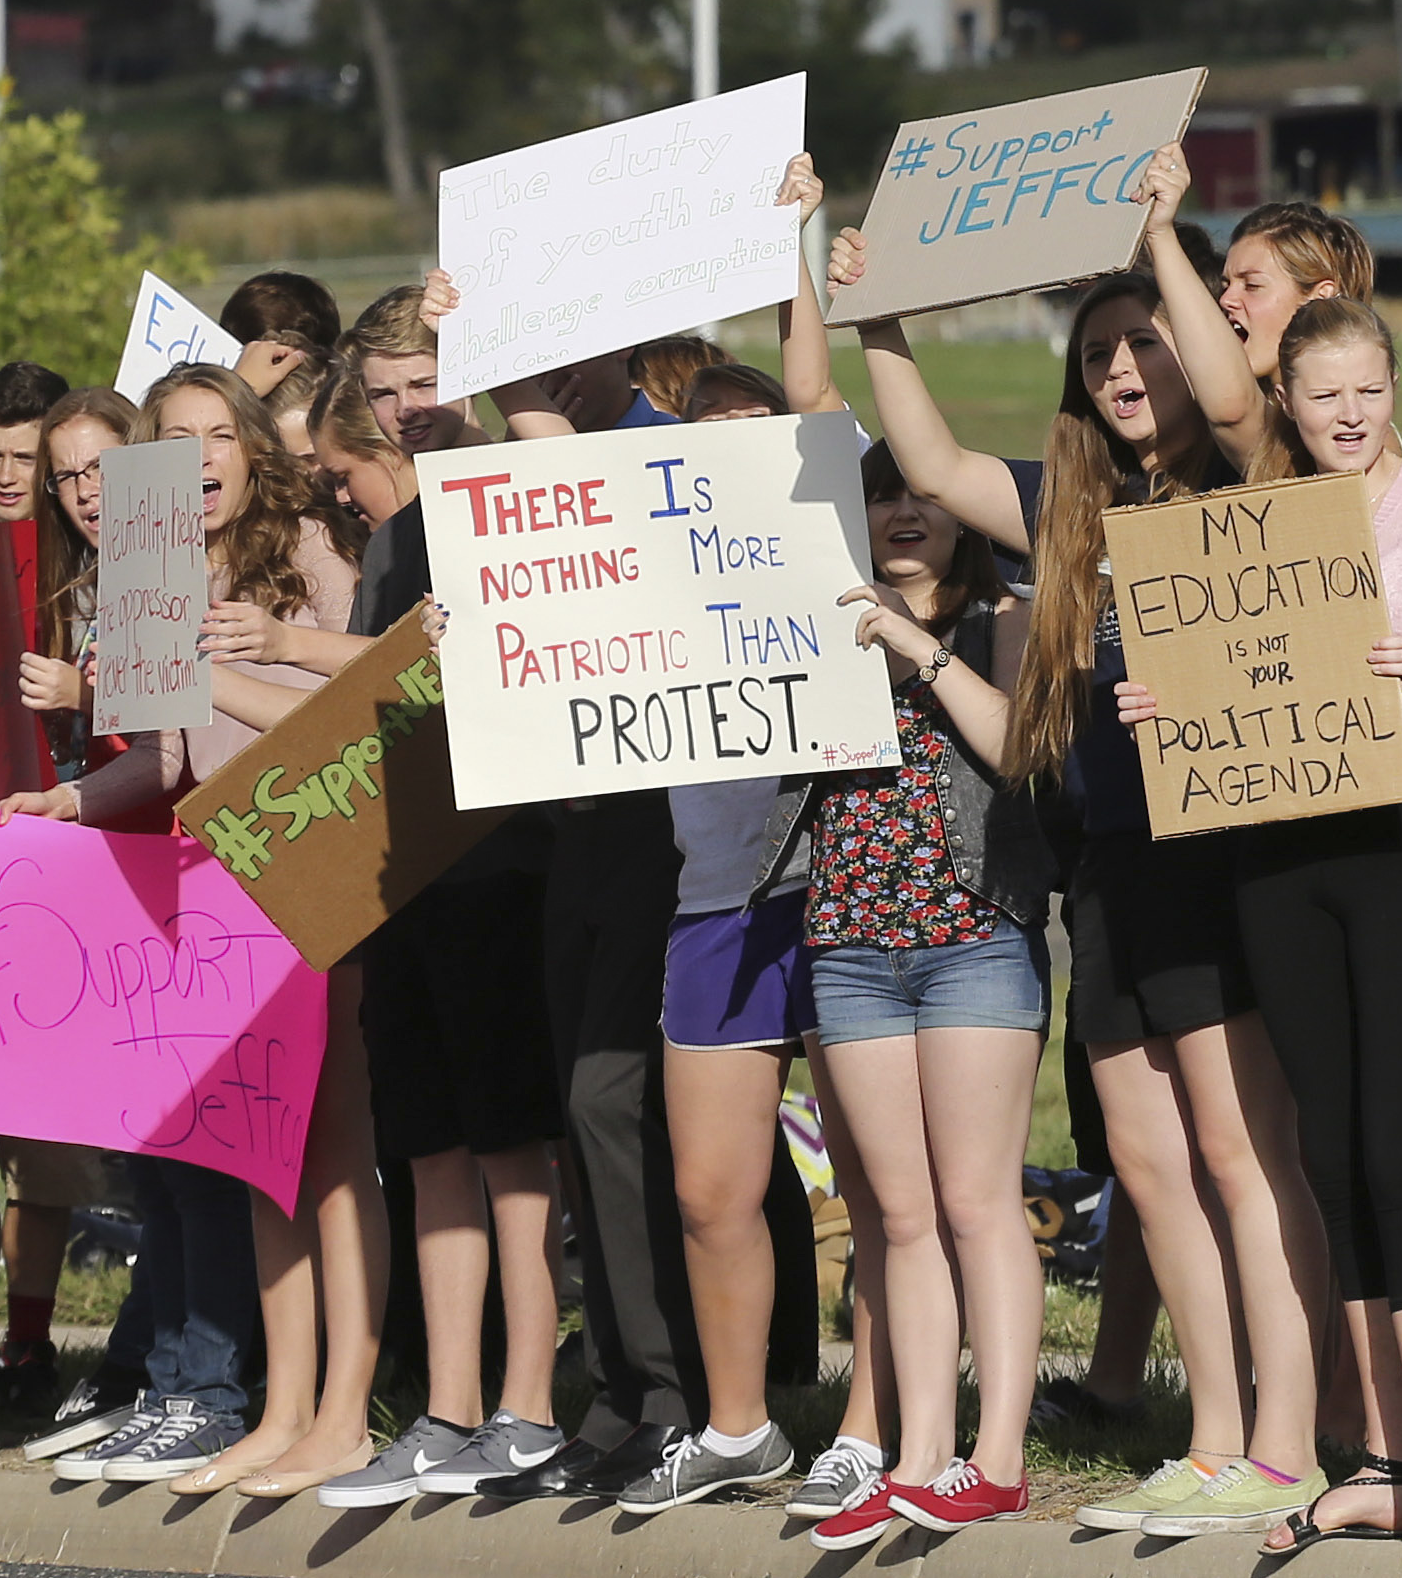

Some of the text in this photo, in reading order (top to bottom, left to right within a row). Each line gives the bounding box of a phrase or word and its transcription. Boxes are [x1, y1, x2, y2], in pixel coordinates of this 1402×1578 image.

[588, 120, 732, 186] duty
[449, 166, 780, 300] of youth is t
[442, 292, 603, 376] challenge
[512, 348, 570, 372] Cobain
[171, 486, 204, 570] helps
[441, 458, 714, 537] THERE IS
[1200, 499, 1273, 556] MY
[479, 524, 786, 605] NOTHING MORE
[1129, 551, 1379, 637] EDUCATION
[132, 642, 155, 698] the
[495, 602, 822, 689] PATRIOTIC THAN
[1243, 661, 1295, 690] YOUR
[1257, 633, 1291, 657] NOT
[569, 673, 819, 766] PROTEST.
[1154, 696, 1397, 765] POLITICAL
[1182, 752, 1360, 813] AGENDA
